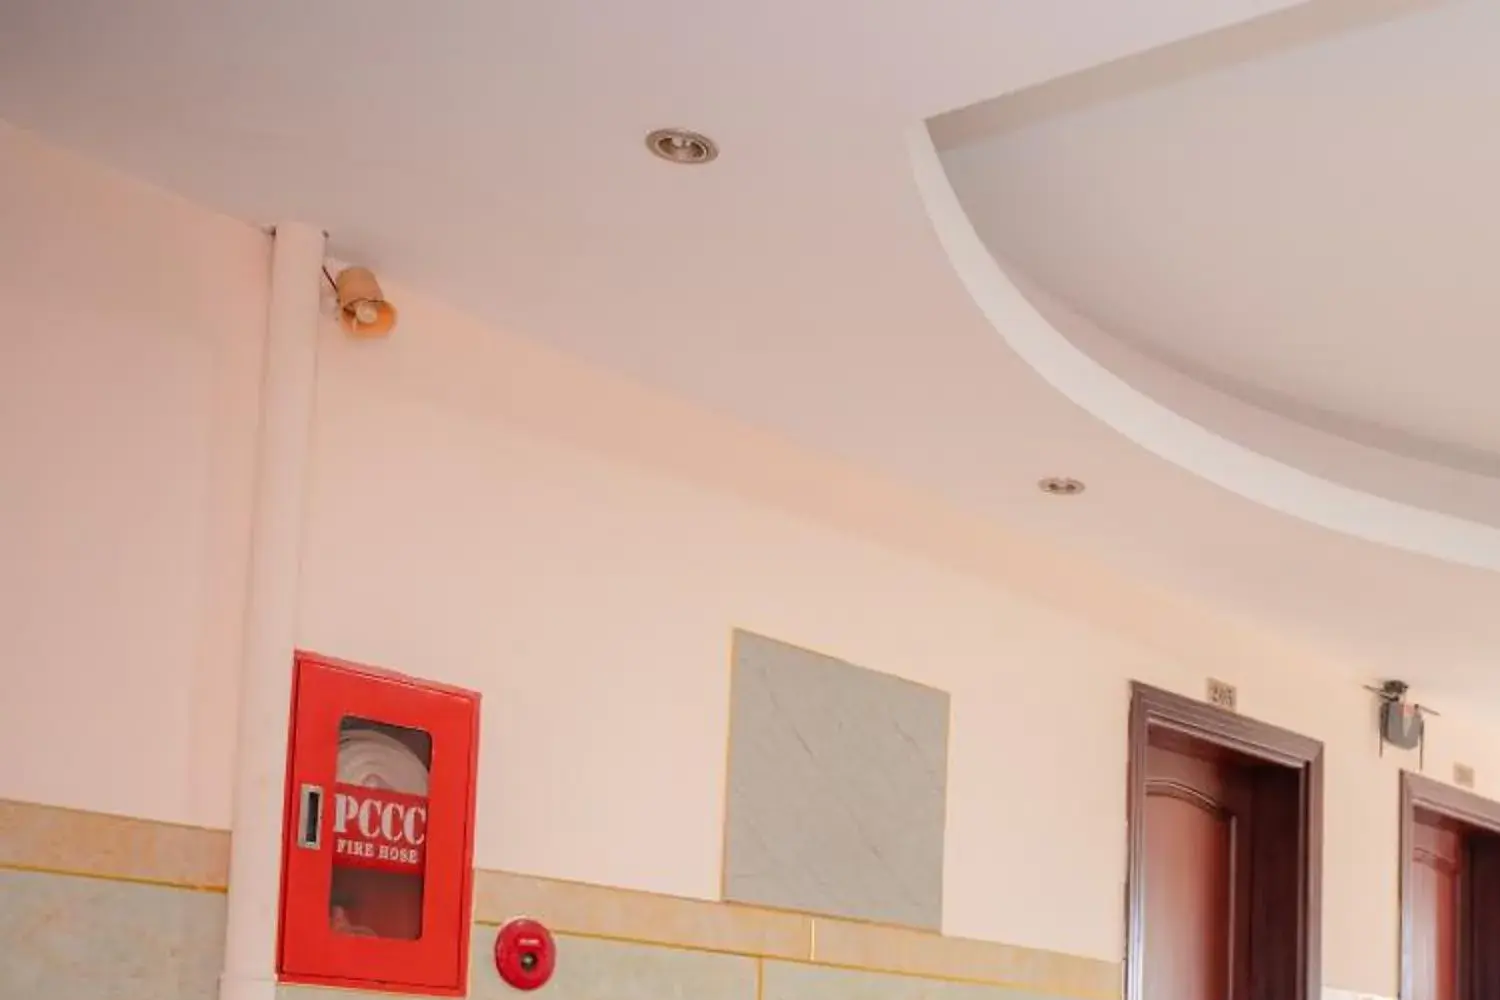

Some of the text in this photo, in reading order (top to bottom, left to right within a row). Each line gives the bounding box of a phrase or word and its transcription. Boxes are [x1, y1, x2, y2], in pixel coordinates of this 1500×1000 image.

[333, 794, 427, 845] PCCC
[336, 839, 418, 864] FIRE HOSE
